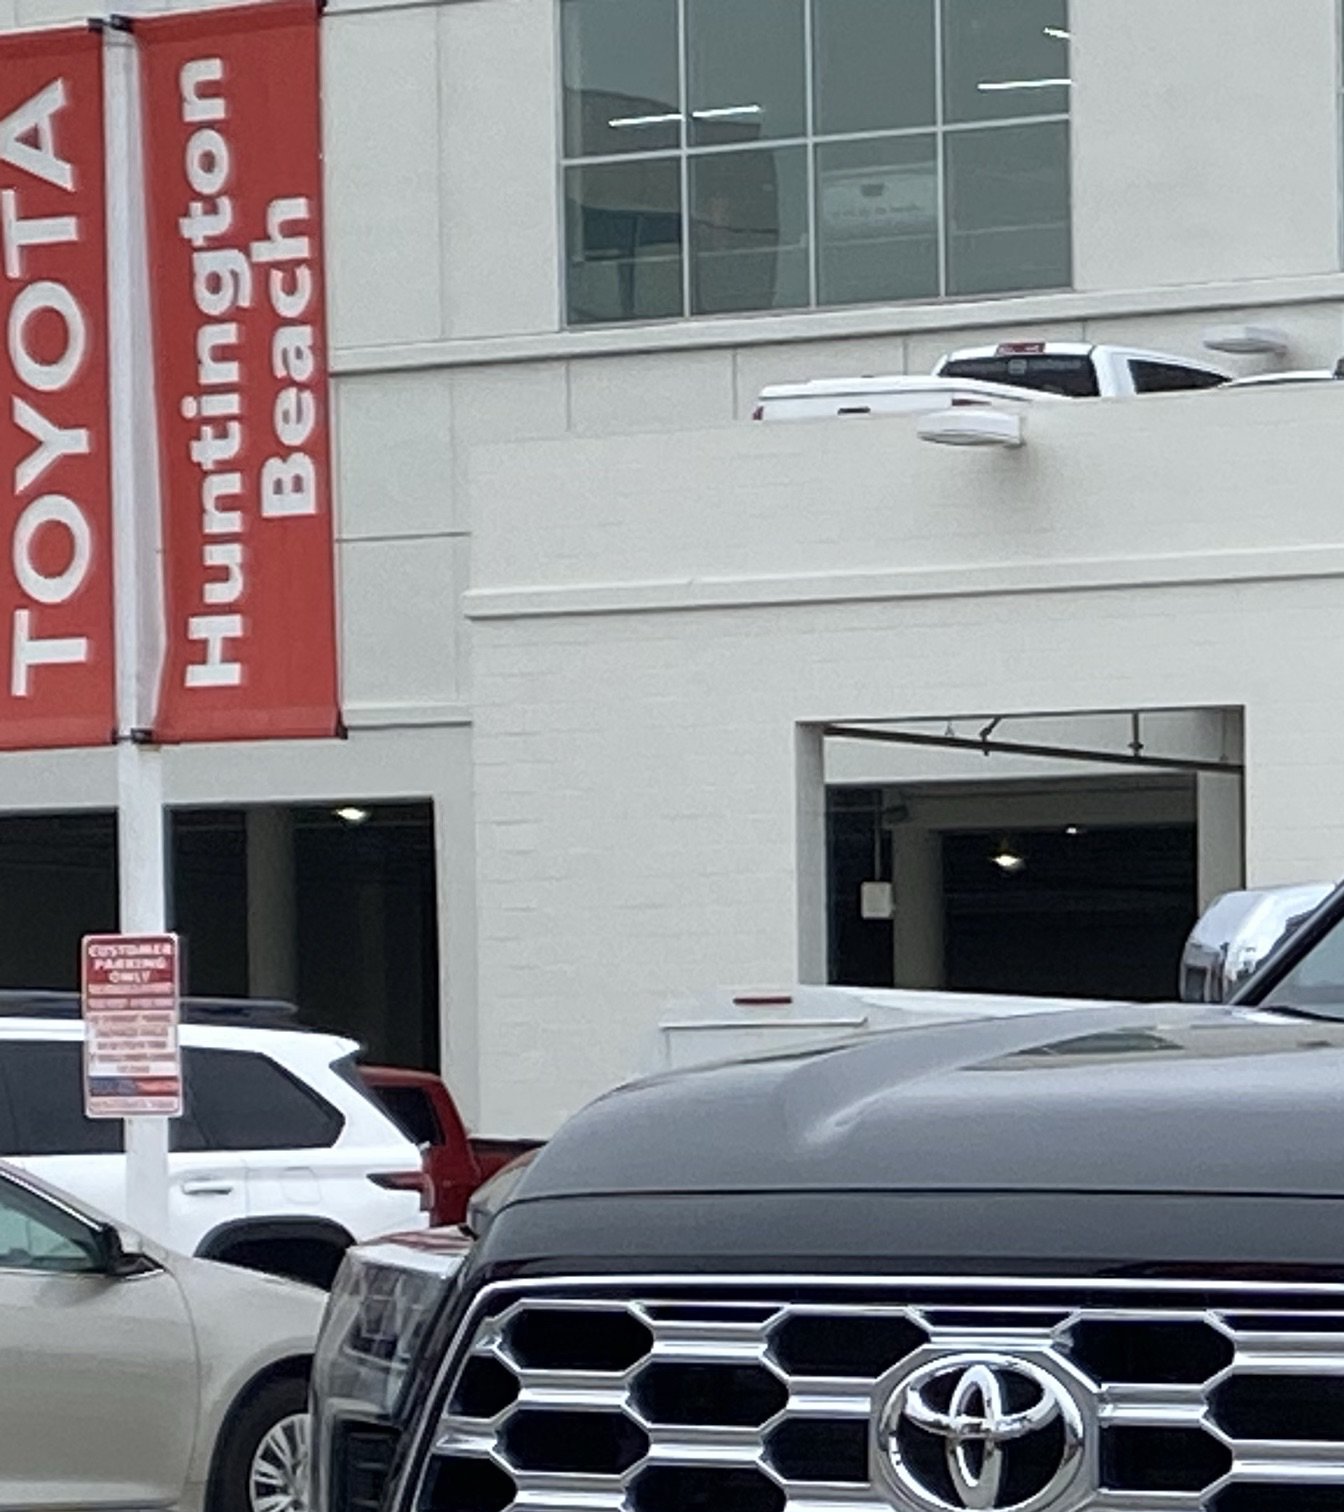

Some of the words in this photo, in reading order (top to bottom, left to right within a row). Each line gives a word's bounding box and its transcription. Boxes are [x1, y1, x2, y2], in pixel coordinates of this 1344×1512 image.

[0, 76, 92, 696] TOYOTA
[179, 56, 252, 688] Huntington
[251, 196, 317, 518] Beach
[88, 944, 172, 957] CUSTOMER
[94, 957, 167, 970] PARKING
[109, 970, 151, 983] ONLY
